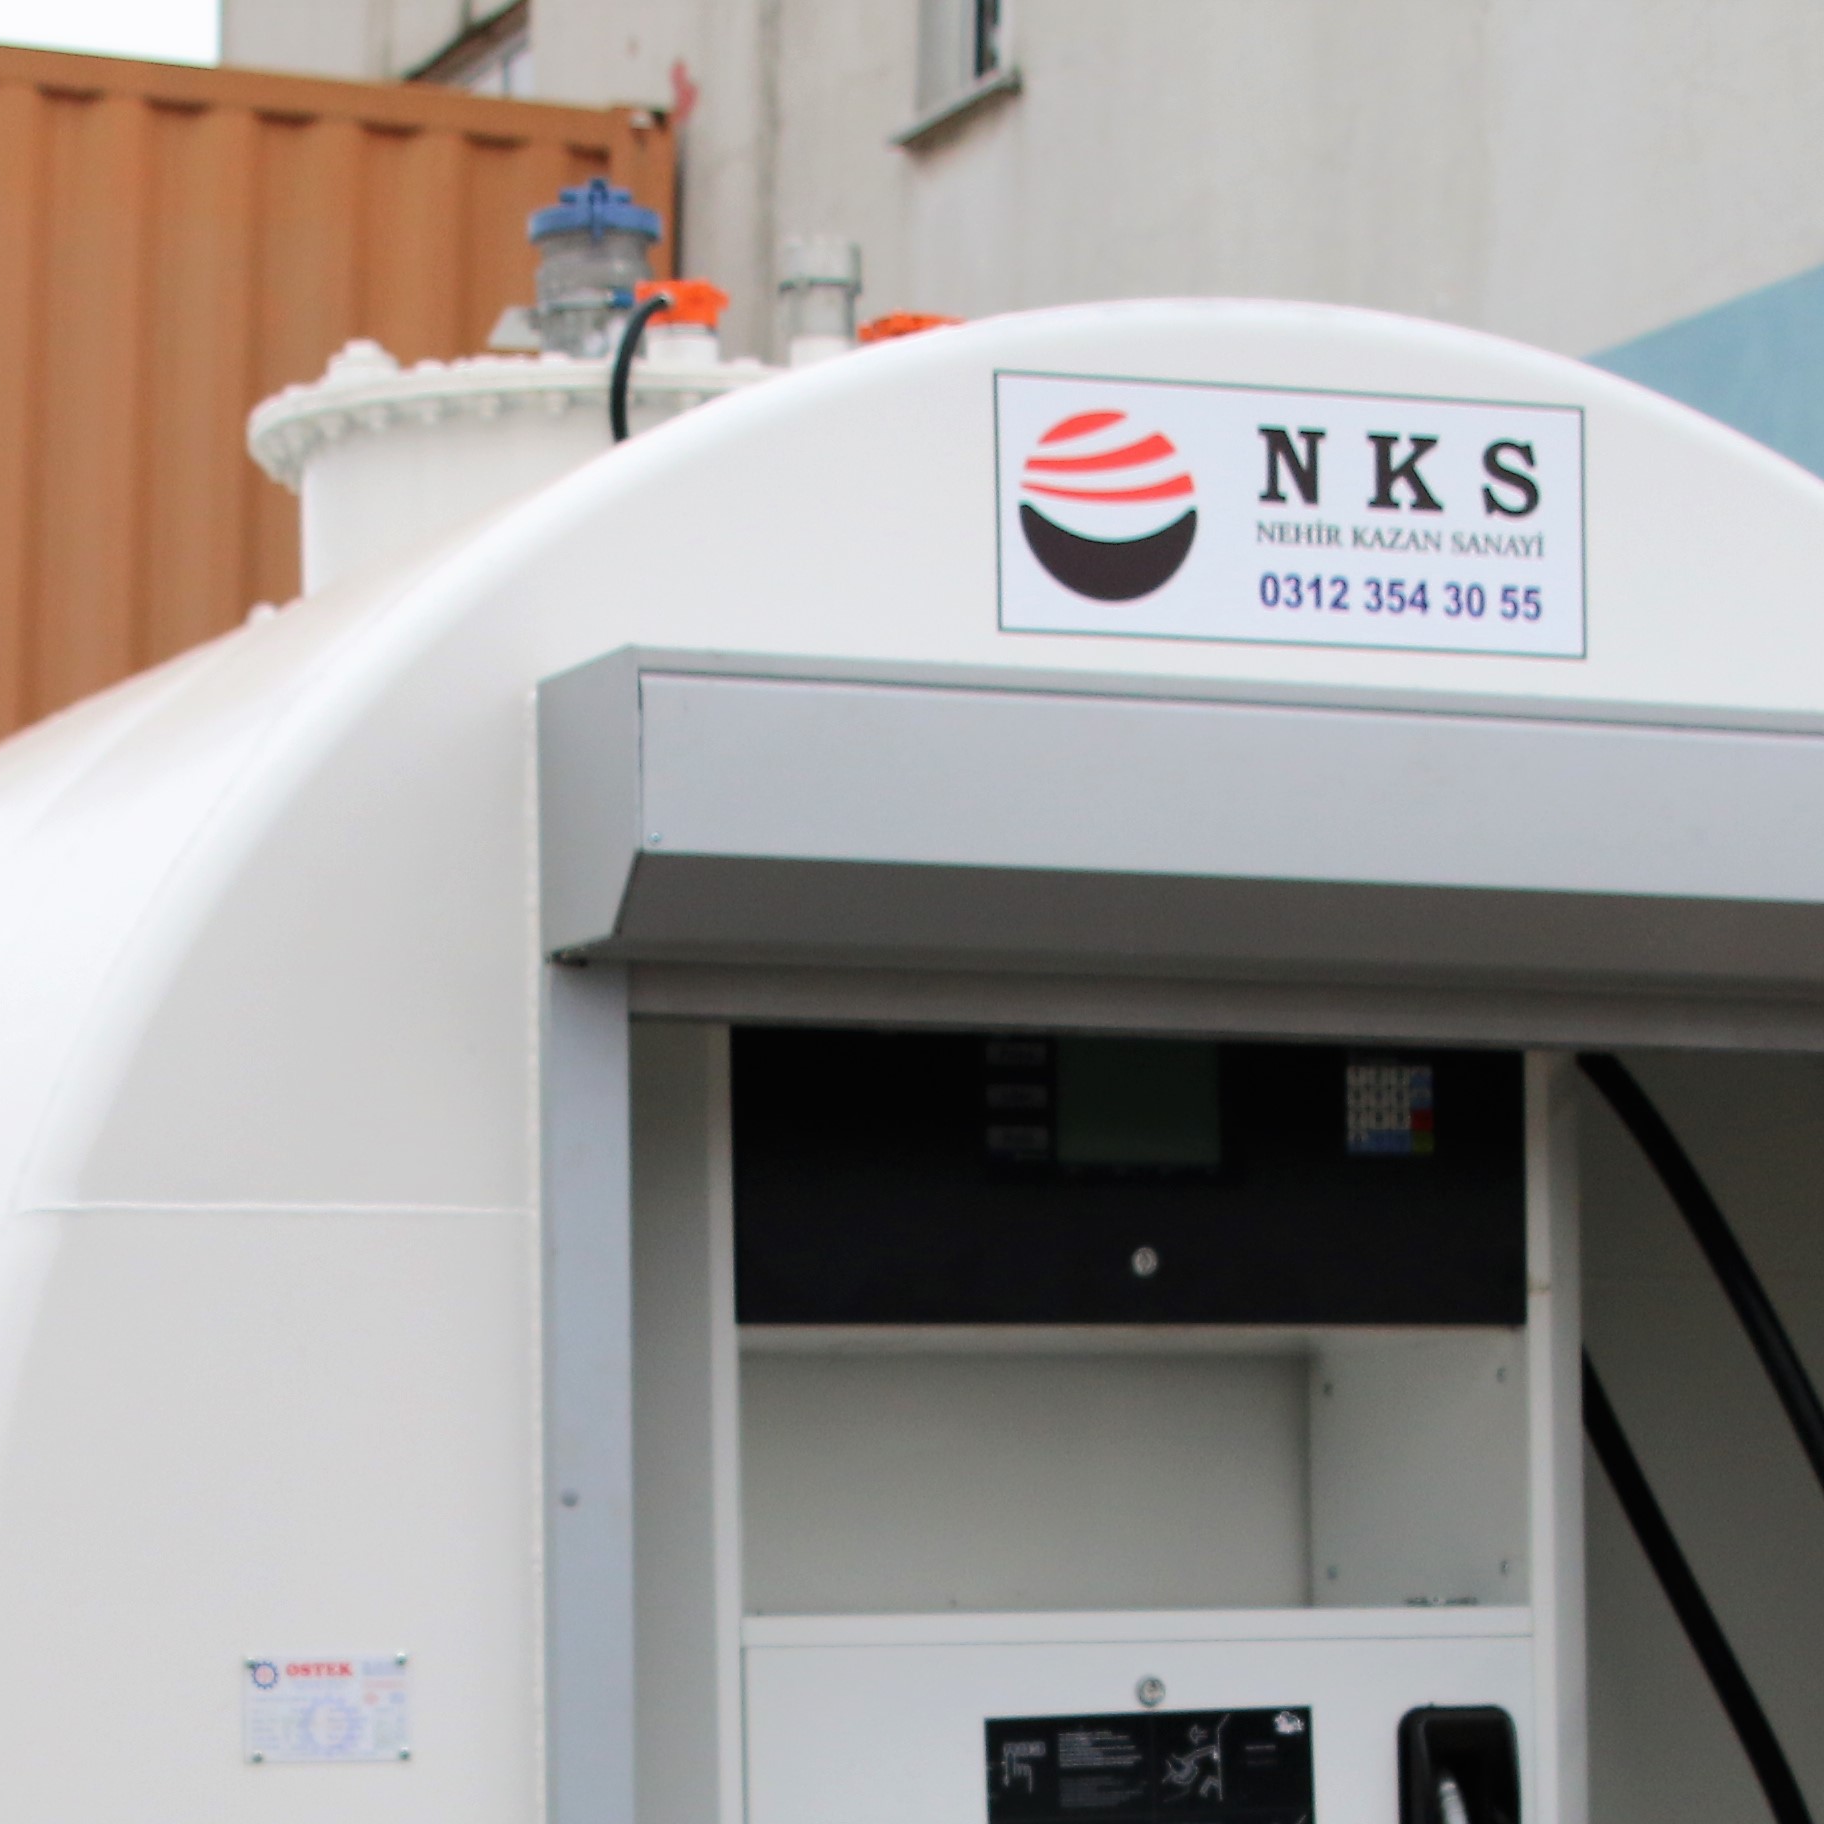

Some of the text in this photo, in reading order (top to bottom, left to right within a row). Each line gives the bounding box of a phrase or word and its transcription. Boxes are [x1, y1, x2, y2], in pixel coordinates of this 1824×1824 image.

[1256, 520, 1546, 558] NEHİR KAZAN SANAYİ
[1259, 571, 1543, 622] 0312 354 30 55
